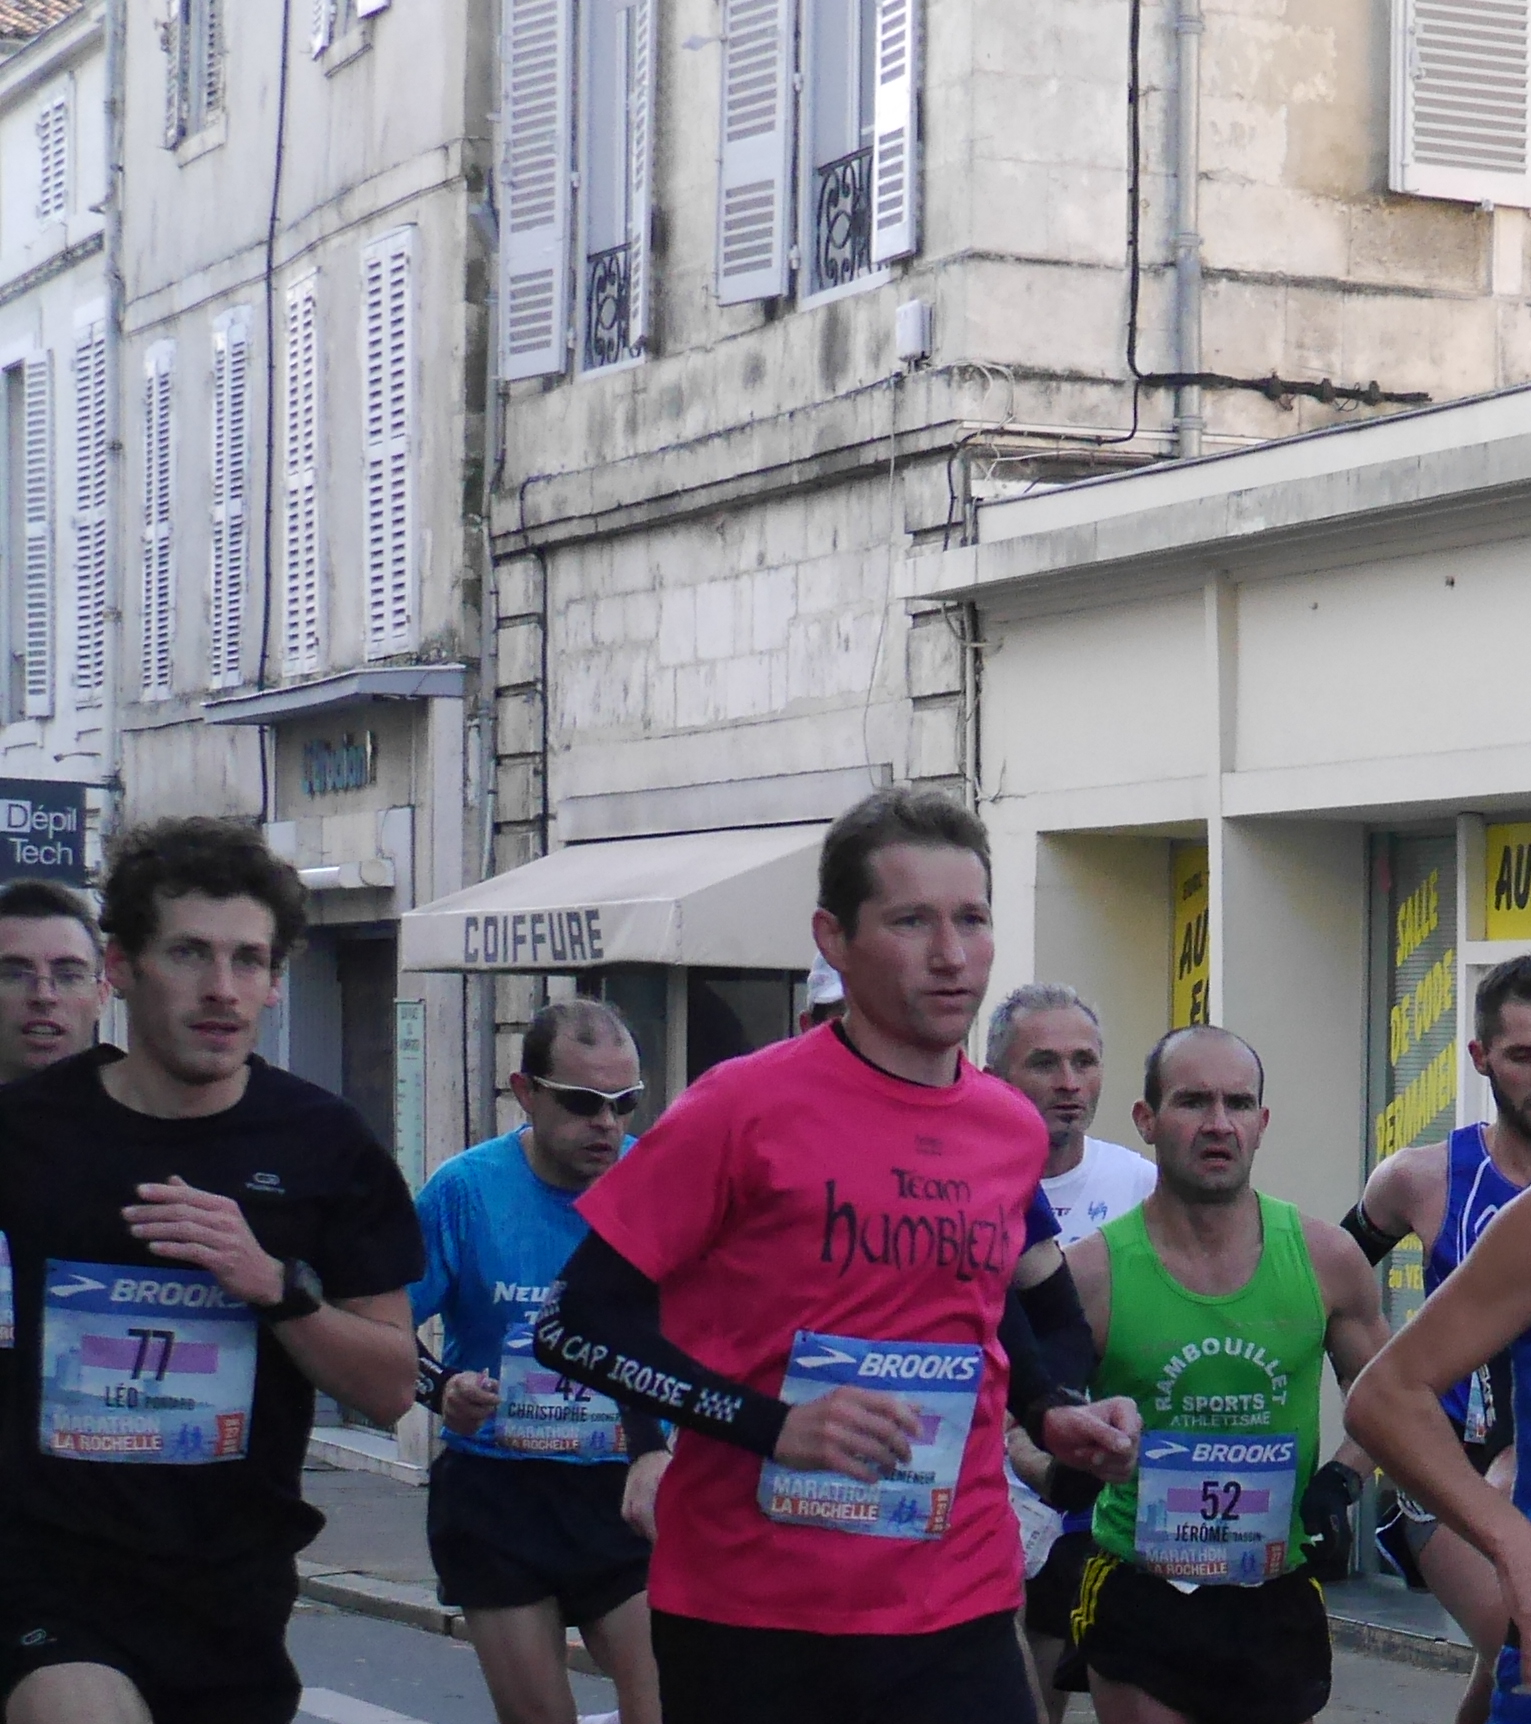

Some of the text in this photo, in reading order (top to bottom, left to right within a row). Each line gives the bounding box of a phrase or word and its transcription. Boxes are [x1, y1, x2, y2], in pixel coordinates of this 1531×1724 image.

[6, 802, 77, 840] Dépil
[9, 838, 73, 866] Tech
[465, 908, 604, 964] COIFFURE
[110, 1278, 247, 1308] BROOK
[128, 1328, 175, 1381] 77
[858, 1353, 979, 1380] BROOKS
[607, 1354, 694, 1407] IROISE
[1156, 1337, 1289, 1412] RAMBOUILLET
[105, 1382, 139, 1410] LÉO
[1182, 1393, 1265, 1412] SPORTS
[507, 1402, 588, 1422] CHRISTOPHE
[54, 1432, 164, 1452] LA ROCHELLE
[1192, 1441, 1295, 1463] BROOKS
[774, 1476, 881, 1503] MARATHON
[1200, 1481, 1242, 1523] 52
[771, 1496, 879, 1522] LA ROCHELLE
[1174, 1522, 1230, 1543] JÉRÔME
[1167, 1561, 1228, 1576] ROCHELLE
